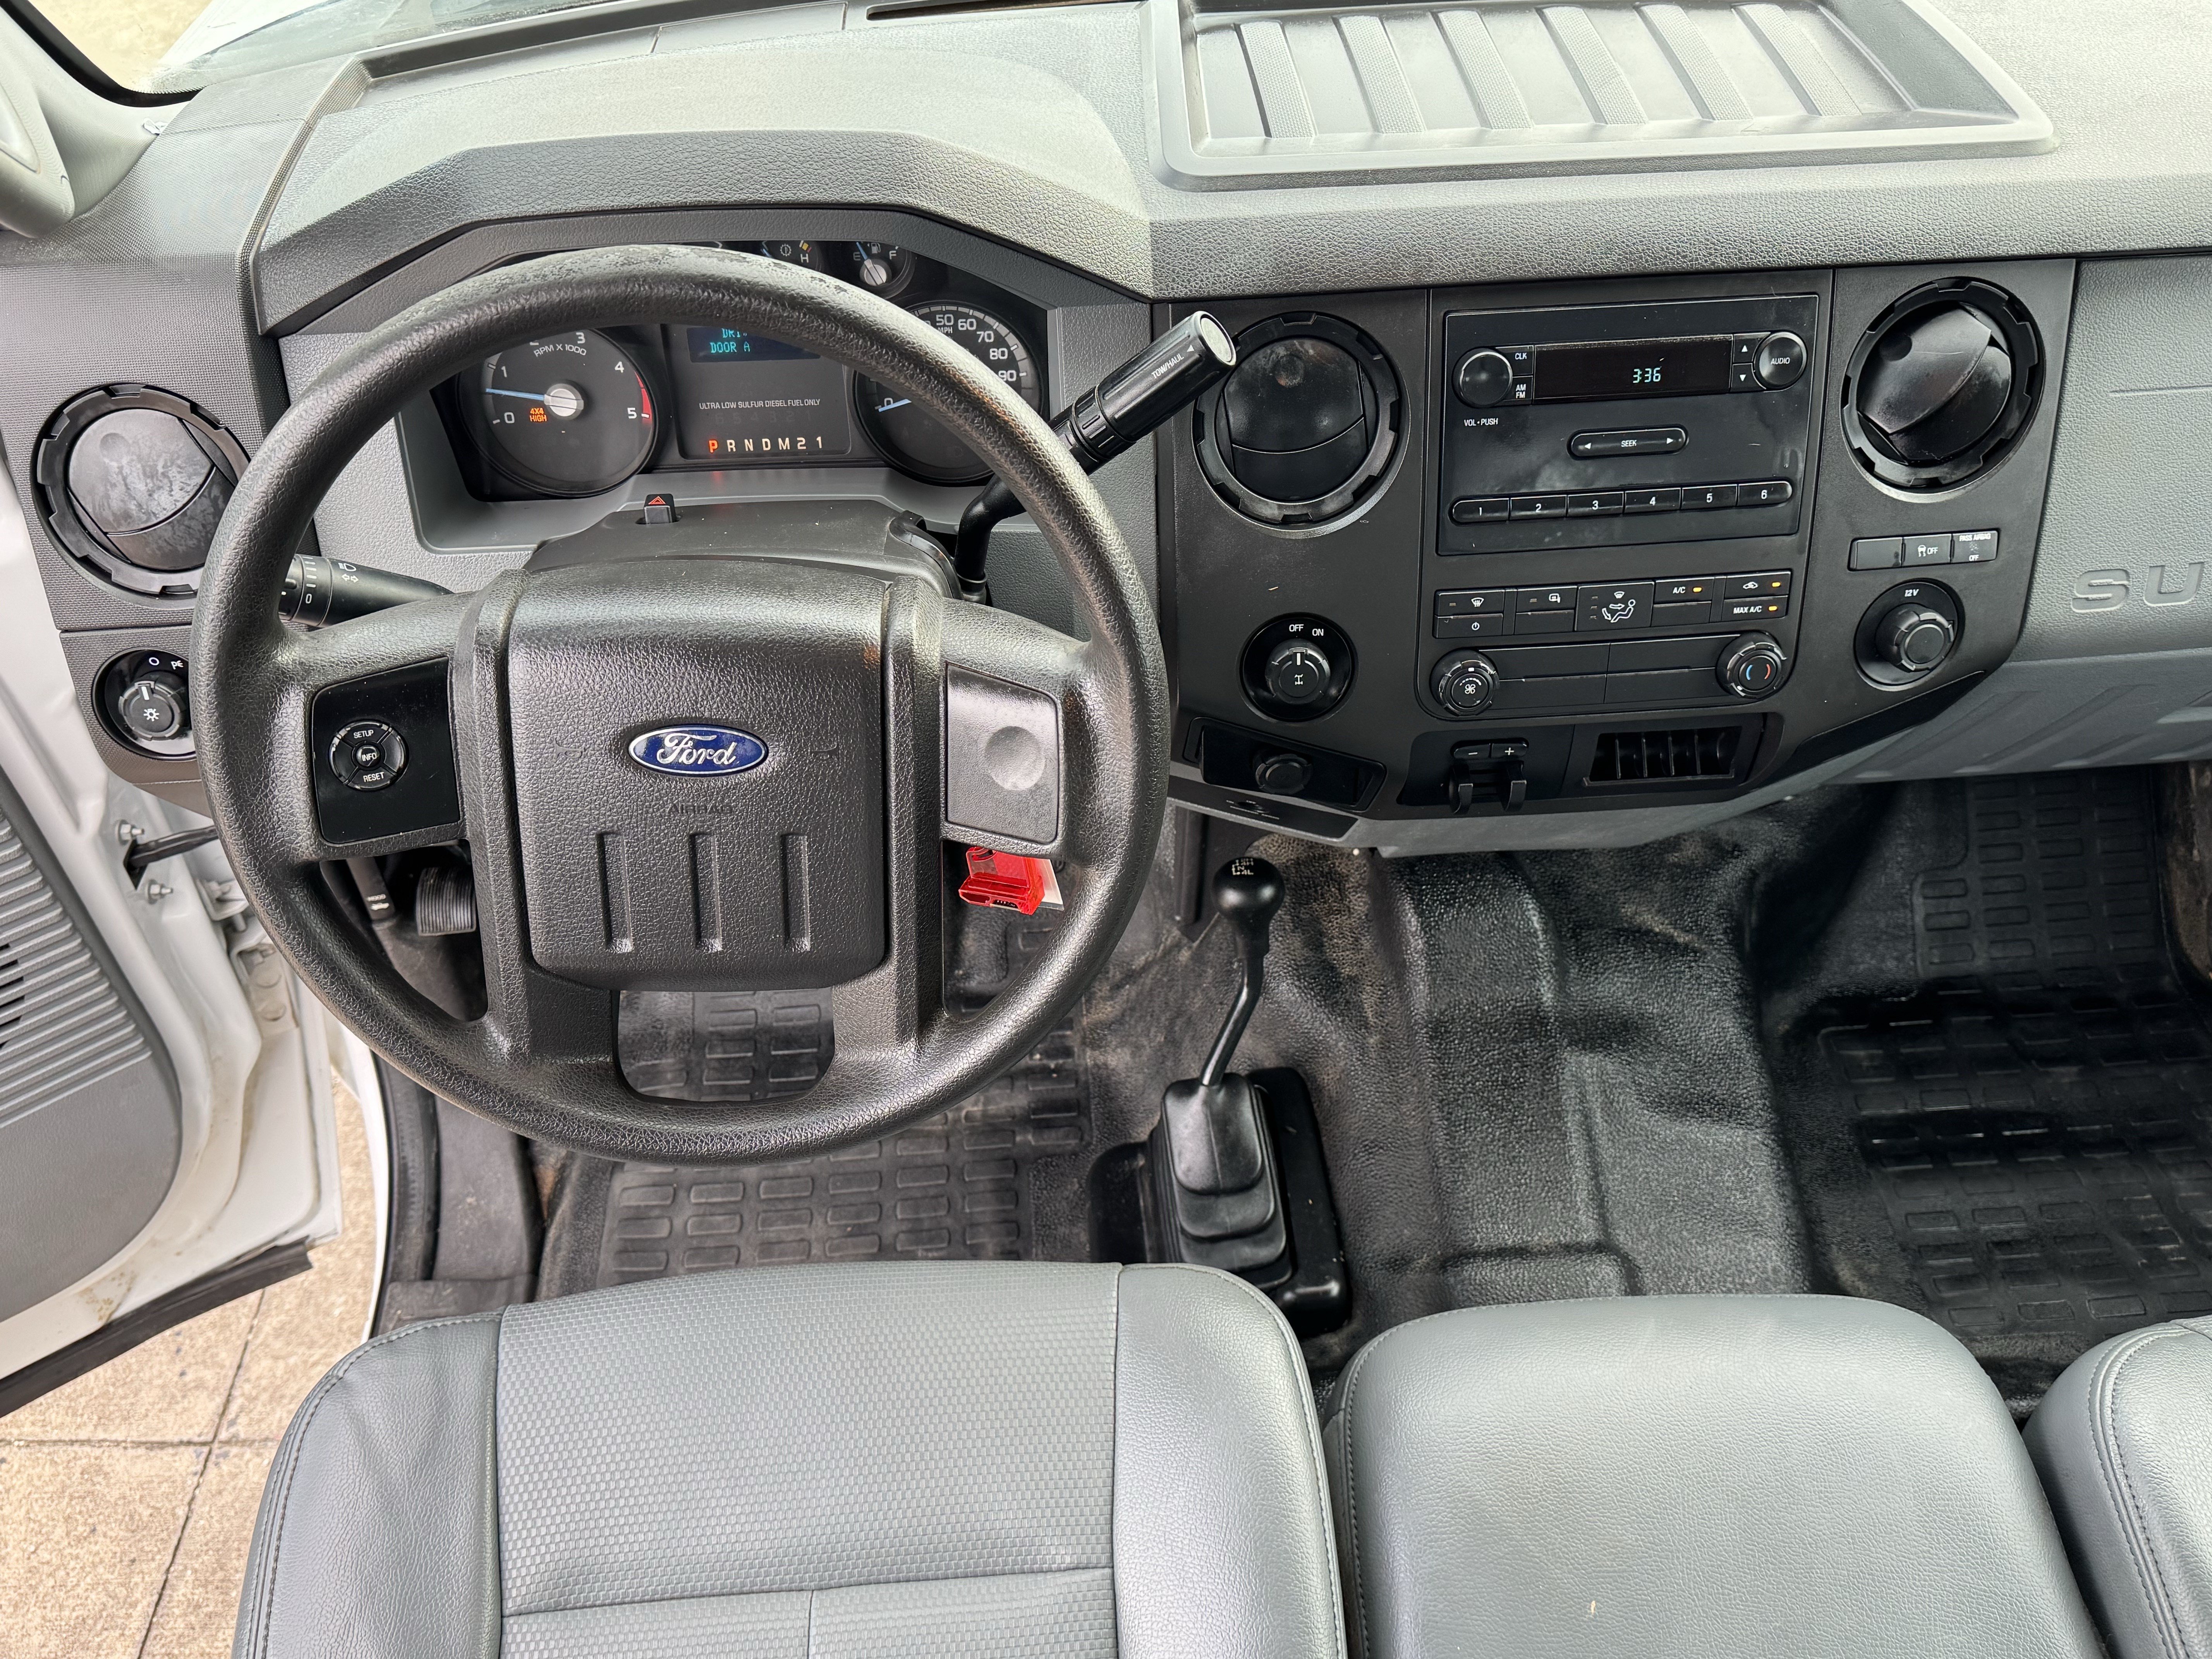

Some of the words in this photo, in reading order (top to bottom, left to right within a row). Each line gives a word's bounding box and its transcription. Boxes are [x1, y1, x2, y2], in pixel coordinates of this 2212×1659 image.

[800, 253, 809, 263] H
[853, 252, 860, 261] E
[889, 250, 896, 259] F
[936, 314, 954, 325] 50
[958, 319, 976, 330] 60
[576, 332, 586, 343] 3
[977, 331, 994, 342] 70
[534, 345, 554, 357] RPM
[565, 344, 586, 356] 1000
[709, 342, 737, 353] DOOR
[989, 348, 1008, 360] 80
[615, 361, 624, 373] 4
[1151, 353, 1184, 378] TOW/HAUL
[501, 366, 507, 377] 1
[998, 370, 1017, 381] 90
[1633, 367, 1661, 383] 3:36
[504, 412, 515, 423] 0
[627, 407, 637, 419] 5
[709, 440, 718, 453] P
[726, 440, 736, 452] R
[744, 439, 754, 451] N
[762, 438, 771, 451] D
[778, 437, 790, 450] M
[797, 437, 806, 450] 2
[816, 436, 822, 448] 1
[1706, 493, 1712, 503] 5
[1761, 490, 1767, 499] 6
[1592, 500, 1599, 510] 3
[1650, 496, 1656, 506] 4
[1479, 507, 1482, 516] 1
[1535, 503, 1541, 513] 2
[1905, 589, 1919, 597] 12V
[2071, 562, 2205, 613] SU
[353, 730, 374, 738] SETUP
[656, 733, 737, 765] Ford
[362, 752, 377, 762] INFO
[363, 772, 385, 782] RESET
